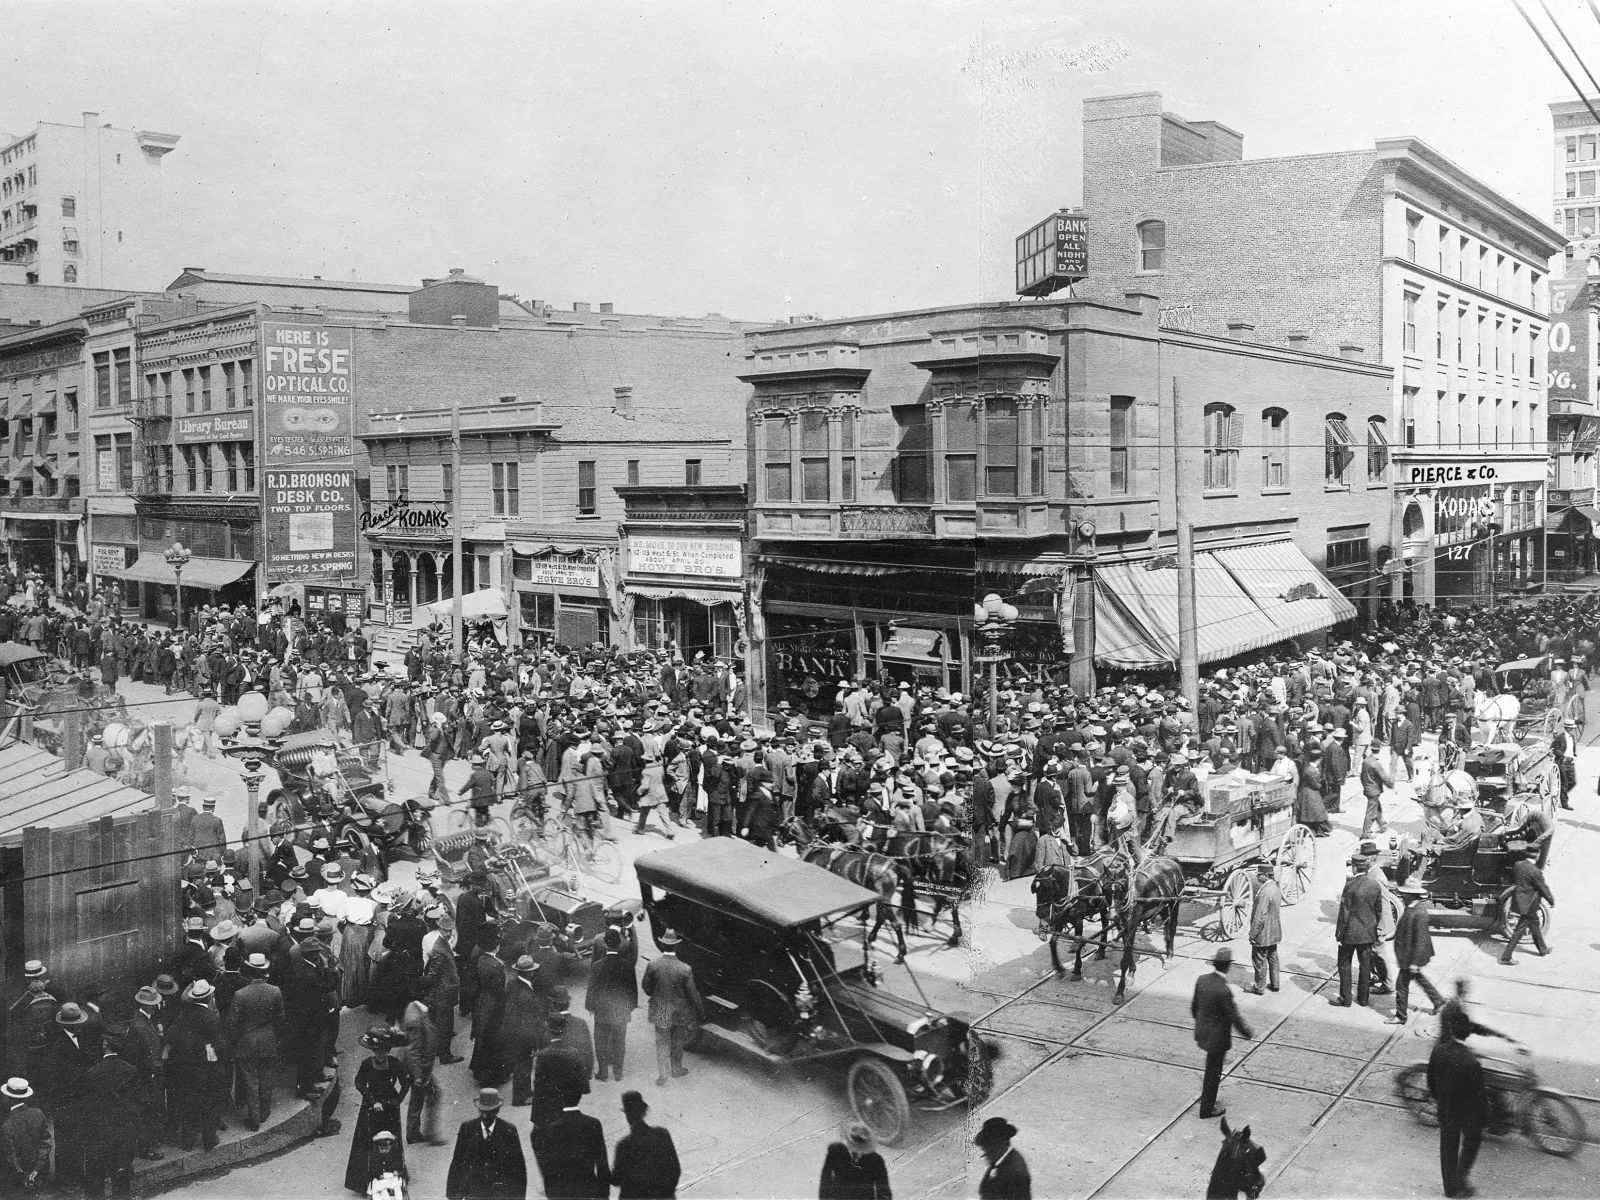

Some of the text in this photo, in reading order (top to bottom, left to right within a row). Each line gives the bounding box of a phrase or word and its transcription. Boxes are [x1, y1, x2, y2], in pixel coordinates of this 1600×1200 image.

[1057, 219, 1087, 233] BANK
[1058, 233, 1086, 241] OPEN
[1057, 251, 1086, 259] NIGHT
[276, 330, 329, 346] HERE IS
[265, 346, 349, 375] FRESE
[266, 375, 350, 393] OPTICAL CO.
[266, 394, 277, 403] WE
[278, 394, 296, 403] MAKE
[296, 394, 313, 404] YOUR
[313, 395, 327, 404] EYES
[179, 417, 248, 434] Library Bureau
[284, 445, 306, 456] 546
[1411, 466, 1463, 483] PIERCE
[1467, 469, 1477, 479] &
[277, 490, 344, 503] DESK CO.
[269, 505, 291, 513] TWO
[1438, 496, 1496, 518] KODAKS
[399, 509, 449, 528] KODAKS
[633, 540, 643, 548] WE
[646, 541, 665, 549] MOVE
[667, 541, 675, 549] TO
[676, 541, 688, 550] OUR
[689, 542, 704, 551] NEW
[271, 553, 310, 561] SOMETHING
[311, 552, 326, 560] NEW
[682, 551, 699, 559] When
[1448, 545, 1472, 560] 127
[286, 564, 309, 573] 542
[638, 563, 677, 572] HOWE
[537, 575, 564, 584] HOWE
[773, 642, 787, 651] ALL
[789, 643, 811, 653] NIGHT
[1039, 651, 1056, 660] DAY
[773, 652, 849, 677] BANK
